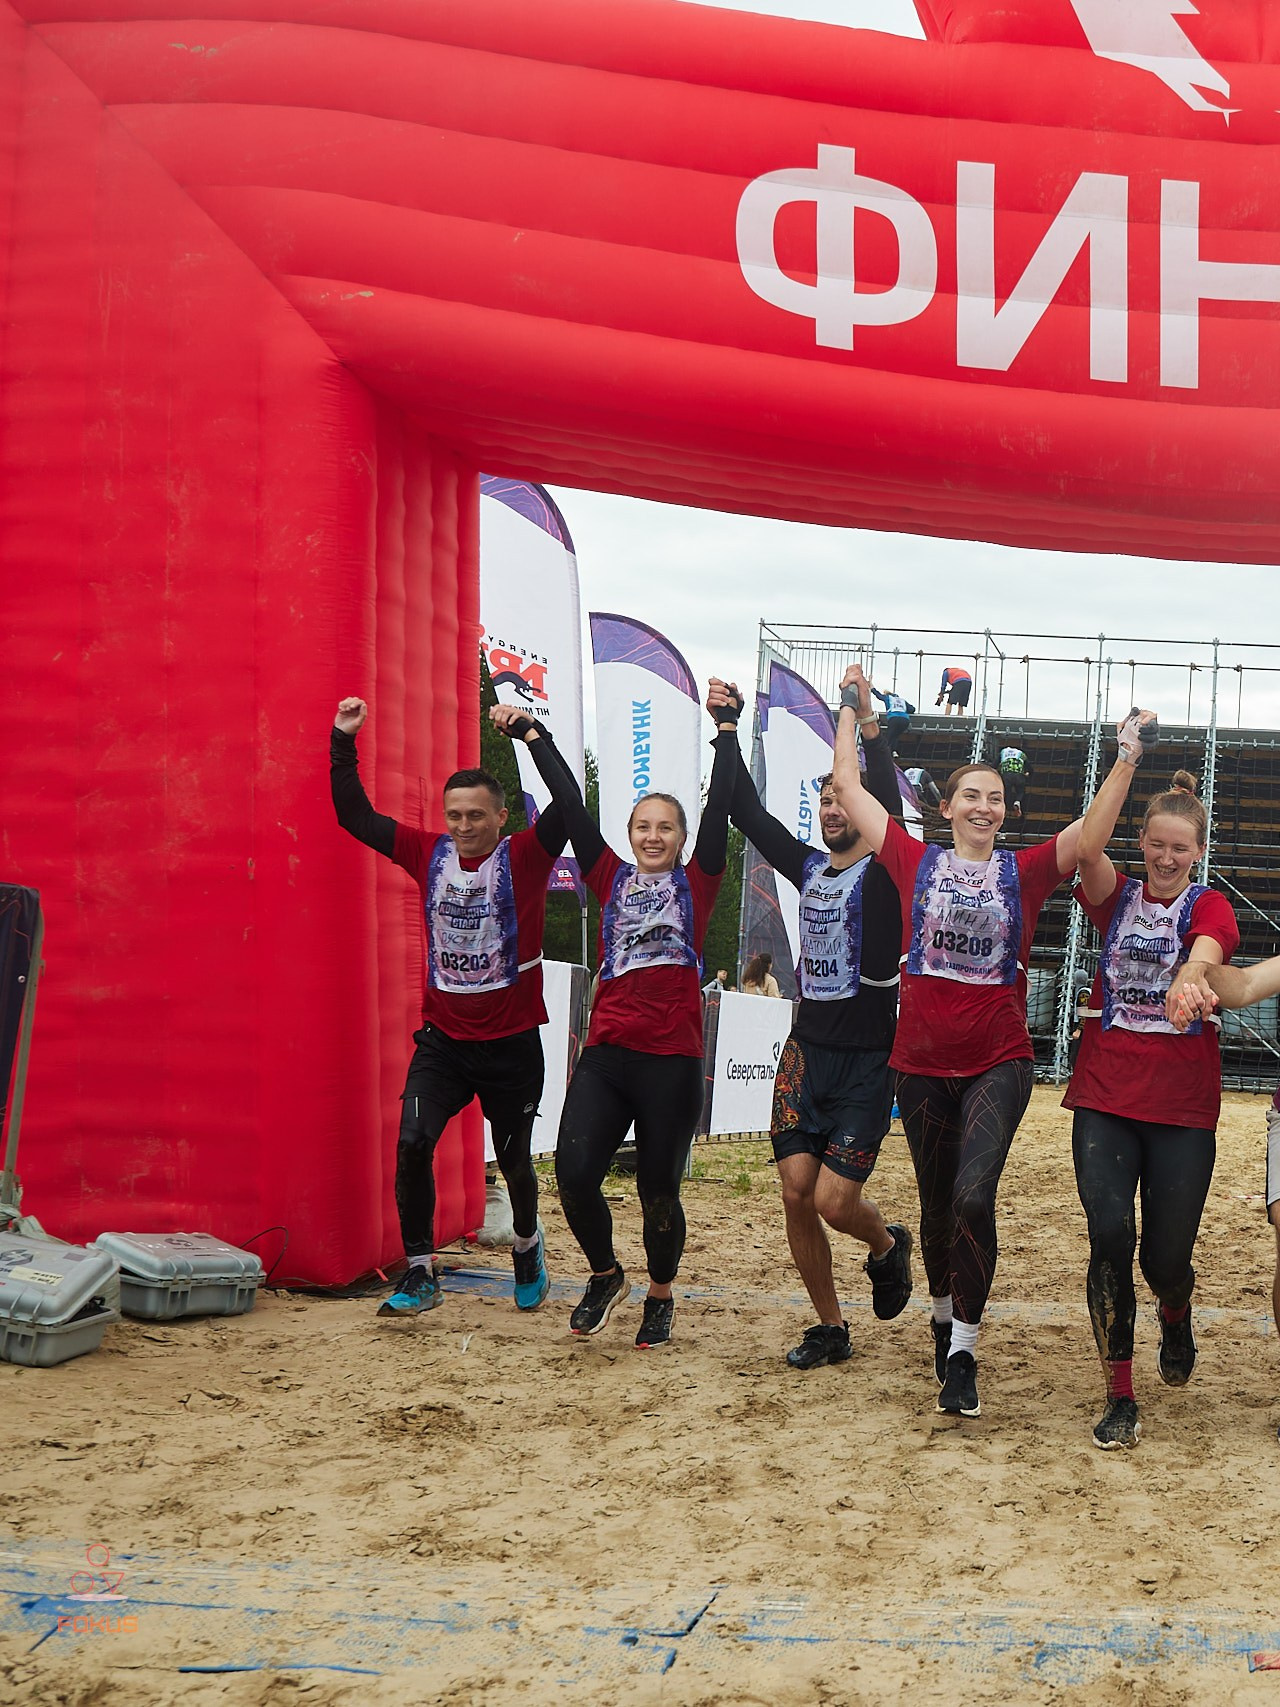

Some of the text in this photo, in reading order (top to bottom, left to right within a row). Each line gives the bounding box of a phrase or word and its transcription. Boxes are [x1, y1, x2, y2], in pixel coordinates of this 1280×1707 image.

[932, 930, 992, 956] 03208
[441, 952, 491, 972] 03203
[805, 957, 839, 977] 03204
[946, 962, 992, 975] ГАЗПРОМБАНК
[727, 1058, 775, 1086] Северсталь
